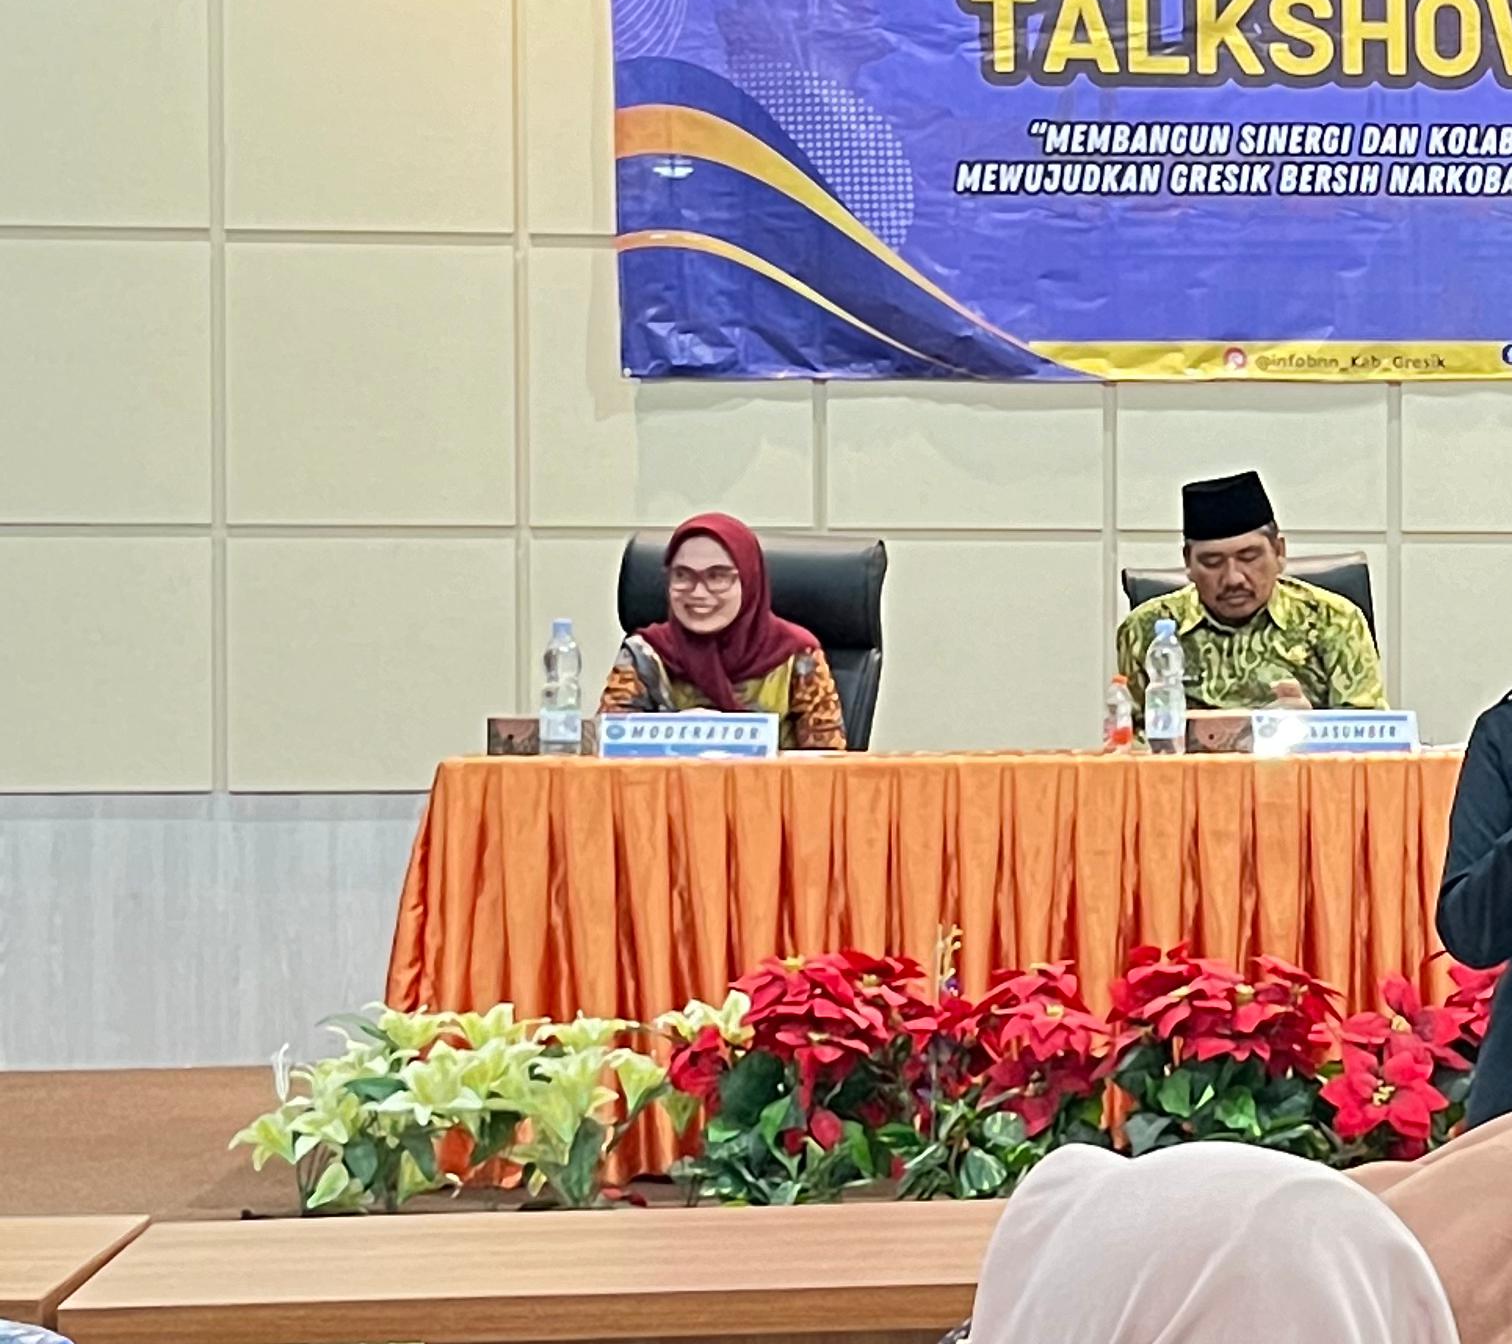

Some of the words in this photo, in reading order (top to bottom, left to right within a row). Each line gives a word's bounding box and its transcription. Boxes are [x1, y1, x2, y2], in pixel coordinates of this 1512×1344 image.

[1238, 125, 1353, 156] SINERGI
[1361, 126, 1419, 156] DAN
[956, 161, 1161, 194] MEWUJUDKAN
[1169, 164, 1270, 194] GRESIK
[1279, 164, 1379, 194] BERSIH
[631, 725, 759, 740] MODERATOR
